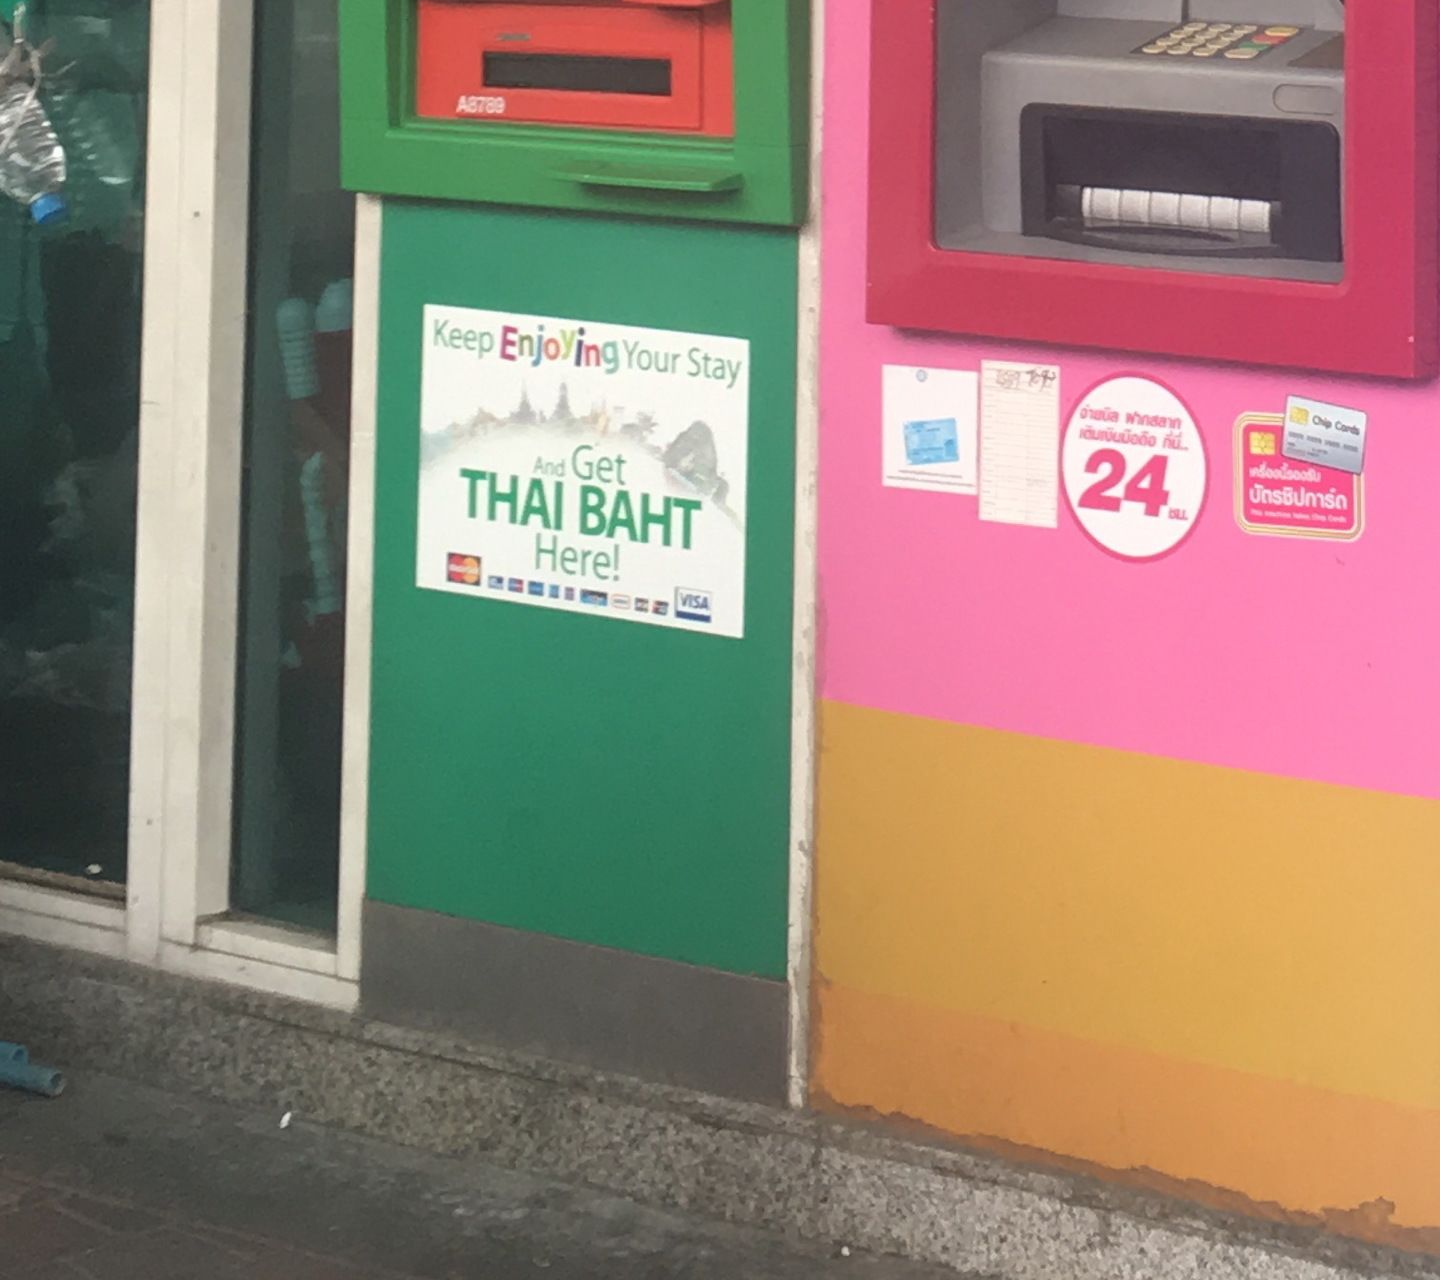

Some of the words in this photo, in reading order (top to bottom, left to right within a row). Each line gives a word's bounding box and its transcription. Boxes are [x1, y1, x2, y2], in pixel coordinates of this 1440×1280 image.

[433, 319, 494, 359] Keep
[500, 325, 620, 374] Enjoying
[623, 340, 681, 372] Your
[687, 347, 742, 389] Stay
[1312, 414, 1333, 430] Chip
[1335, 420, 1361, 437] Cards
[533, 455, 565, 477] And
[572, 444, 627, 486] Get
[1078, 448, 1170, 517] 24
[460, 468, 563, 531] THAI
[579, 485, 702, 550] BAHT
[535, 532, 620, 581] Here!
[679, 593, 710, 612] VISA
